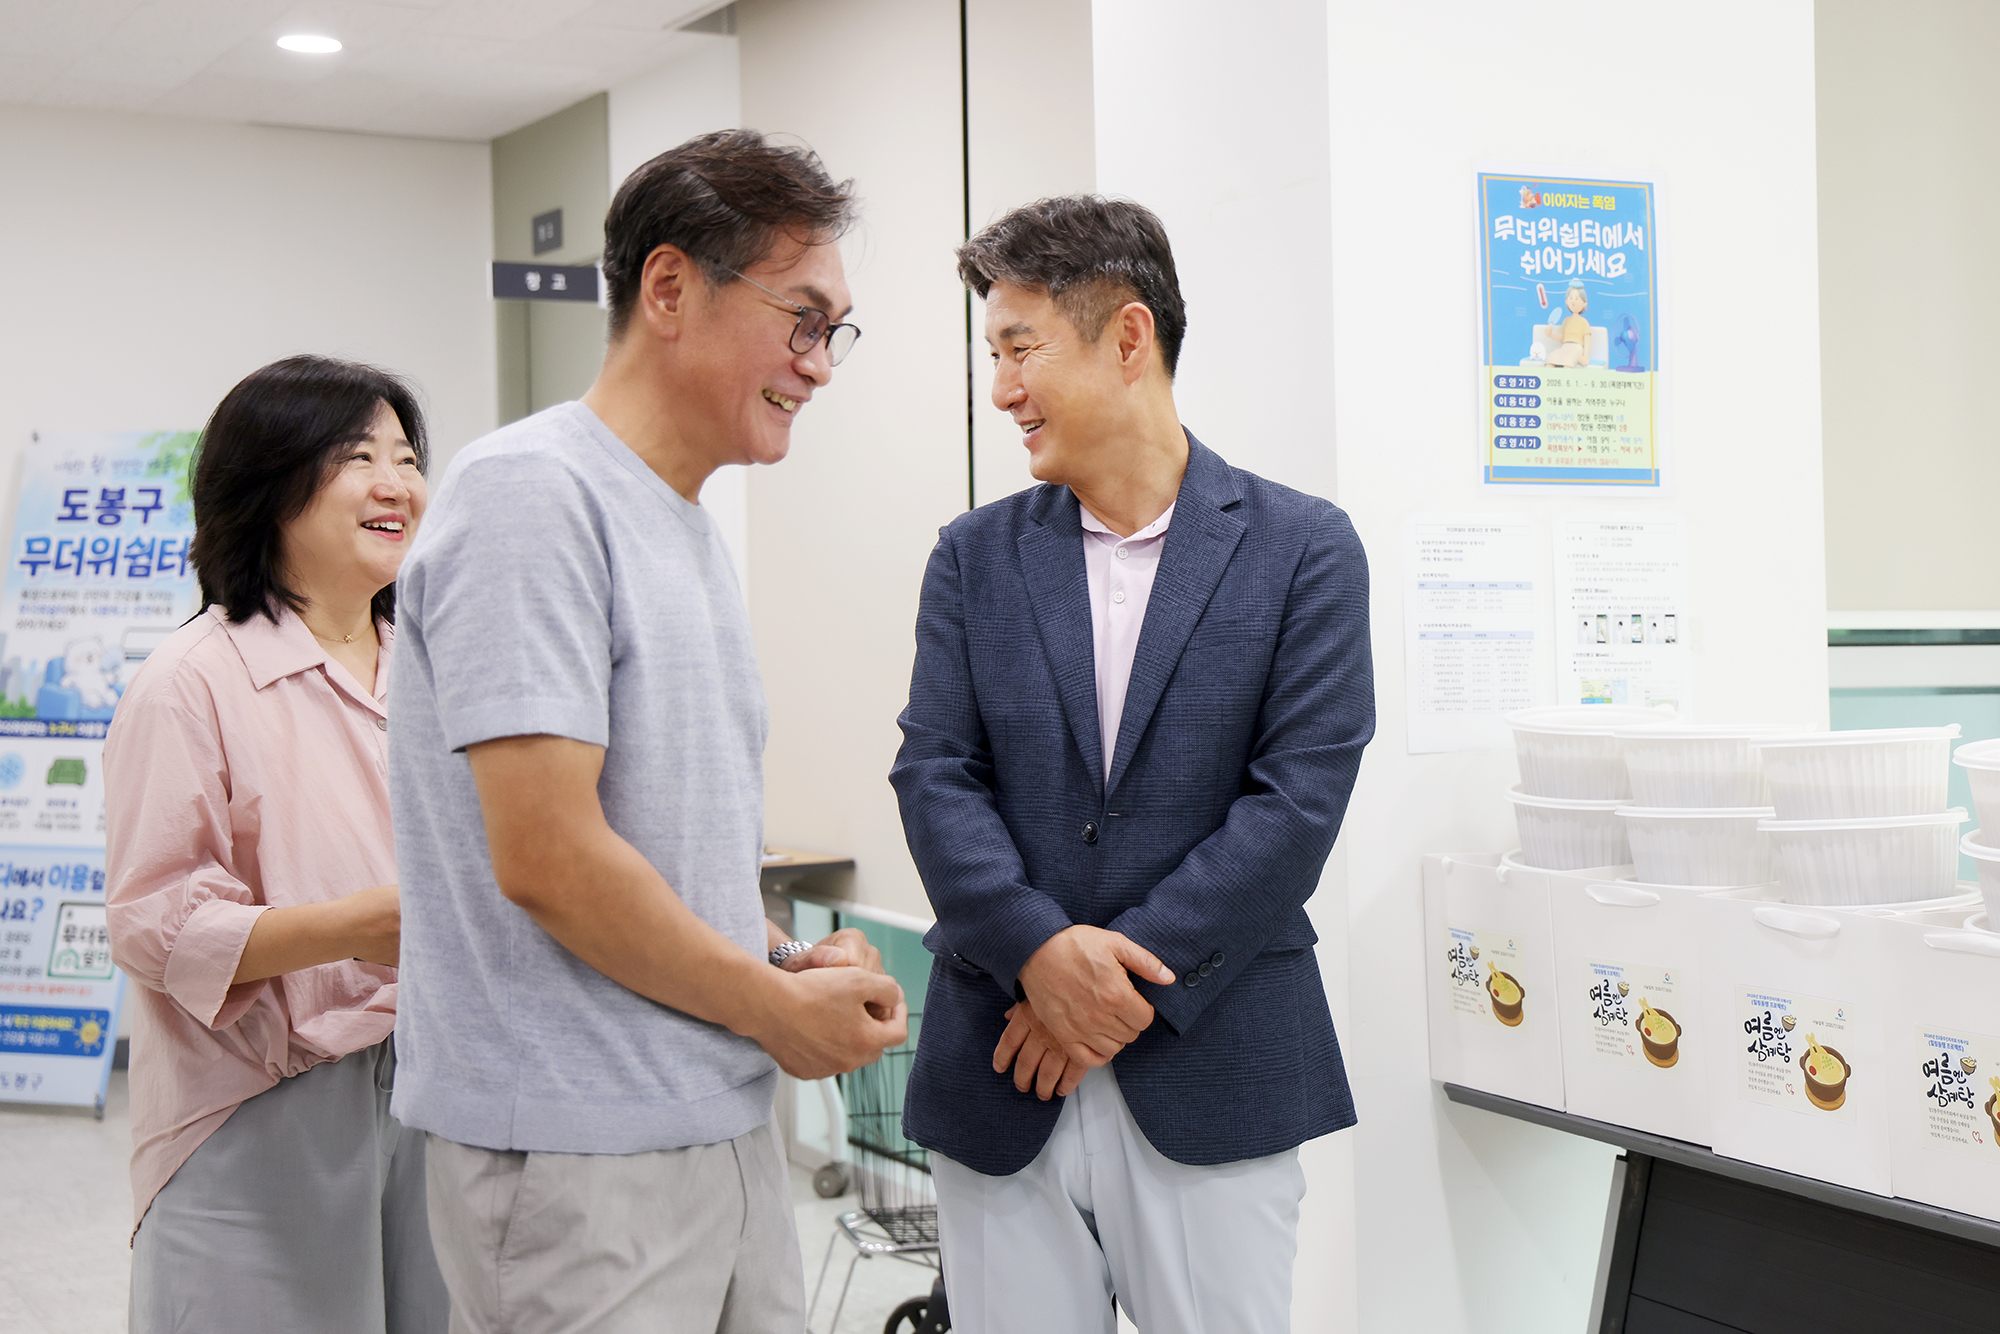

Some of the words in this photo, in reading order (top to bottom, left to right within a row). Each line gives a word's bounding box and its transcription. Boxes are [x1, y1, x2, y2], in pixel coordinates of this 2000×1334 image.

[1542, 193, 1590, 209] 이어지는
[1592, 195, 1616, 210] 폭염
[1494, 215, 1643, 250] 무더위쉼터에서
[1520, 246, 1627, 278] 쉬어가세요
[1499, 377, 1536, 388] 운영기간
[1499, 397, 1536, 407] 이용대상
[1499, 417, 1536, 427] 이용장소
[1499, 438, 1536, 448] 운영시기
[57, 488, 164, 526] 도봉구
[19, 536, 190, 578] 무더위쉼터
[1589, 979, 1622, 1006] 여름엔
[1593, 1004, 1628, 1026] 삼계탕
[1744, 1011, 1786, 1041] 여름엔
[1747, 1038, 1792, 1063] 삼계탕
[1922, 1052, 1967, 1085] 여름엔
[1927, 1081, 1975, 1109] 삼계탕
